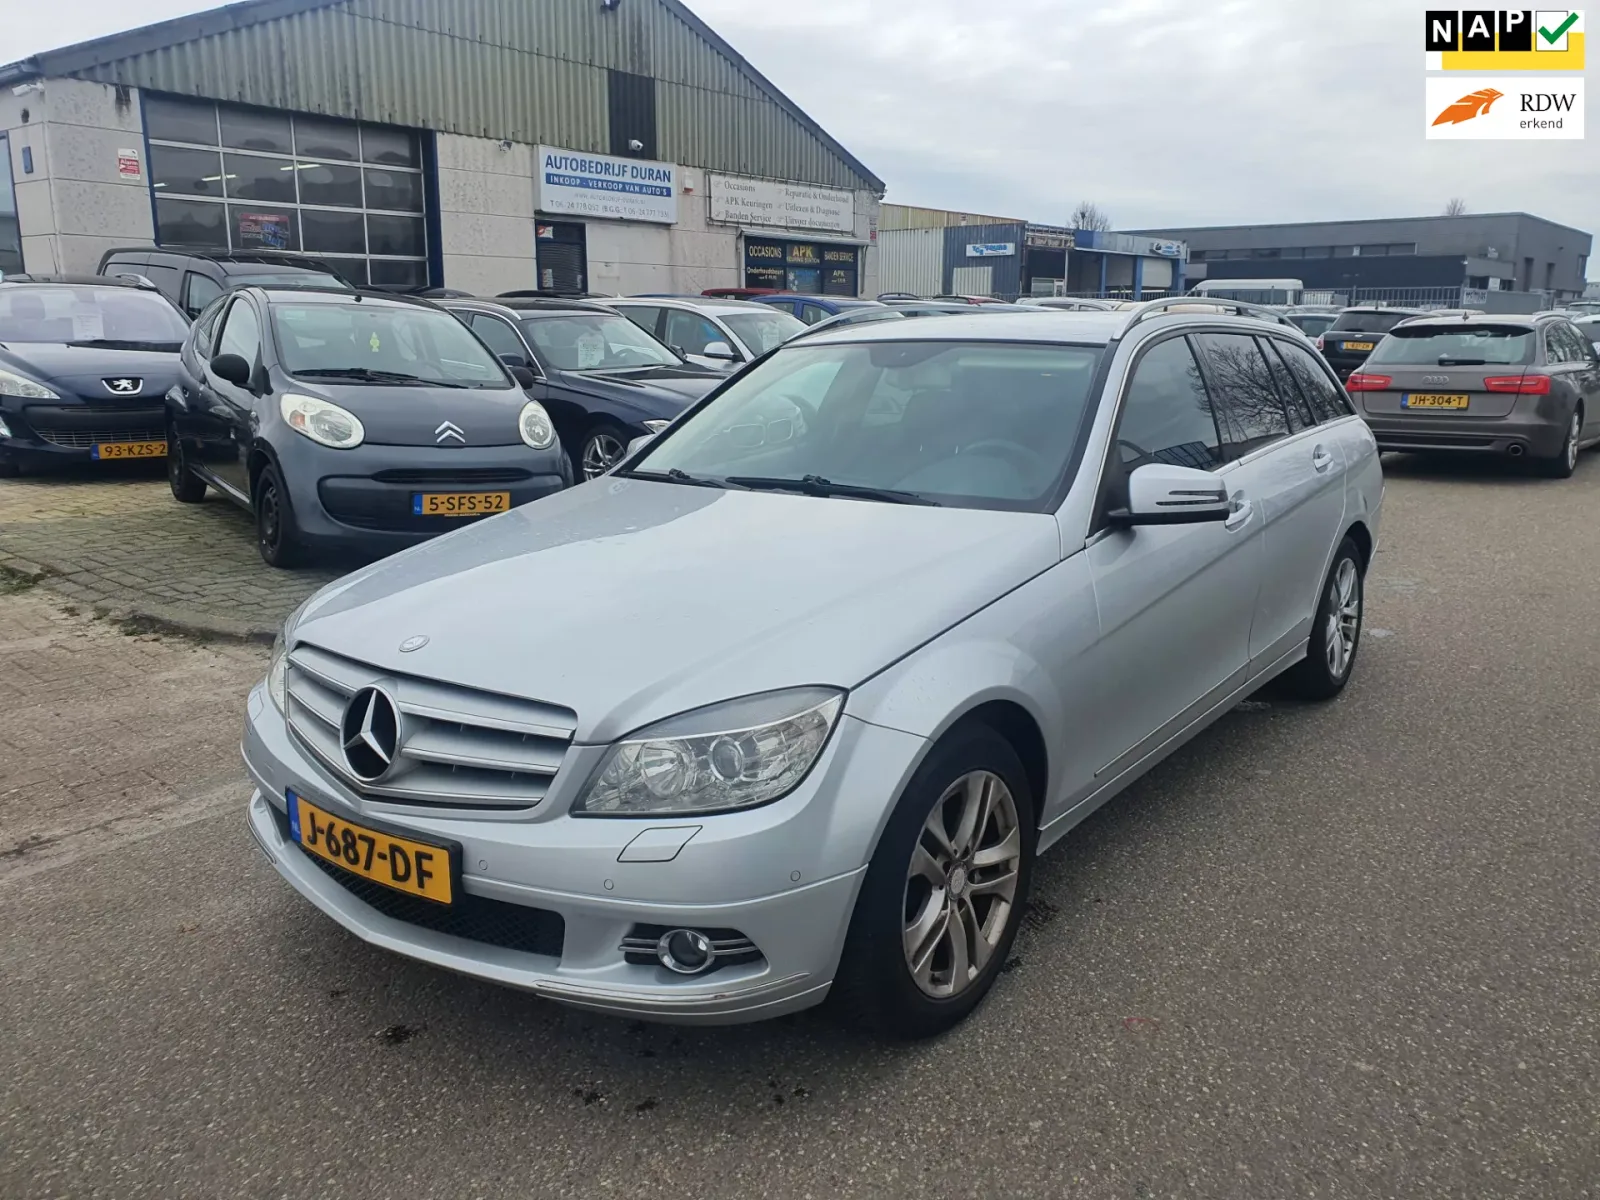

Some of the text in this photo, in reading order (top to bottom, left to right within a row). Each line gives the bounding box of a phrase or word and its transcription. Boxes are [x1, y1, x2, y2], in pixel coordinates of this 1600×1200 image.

[545, 155, 671, 183] AUTOBEDRIJF DURAN
[550, 175, 580, 186] INKOOP
[588, 180, 623, 191] VERKOOP
[625, 184, 640, 193] VAN
[642, 187, 667, 196] AUTO'S
[725, 180, 756, 192] Occasions
[725, 197, 773, 210] APK Keuringen
[725, 210, 772, 223] Banden Service
[748, 245, 782, 258] OCCASIONS
[792, 246, 813, 257] APK
[839, 252, 854, 263] SERVICE
[1411, 394, 1464, 406] JH-304-T
[104, 443, 167, 457] 93-KZS-2
[429, 494, 504, 512] 5-SFS-52
[307, 812, 433, 889] J-687-DF
